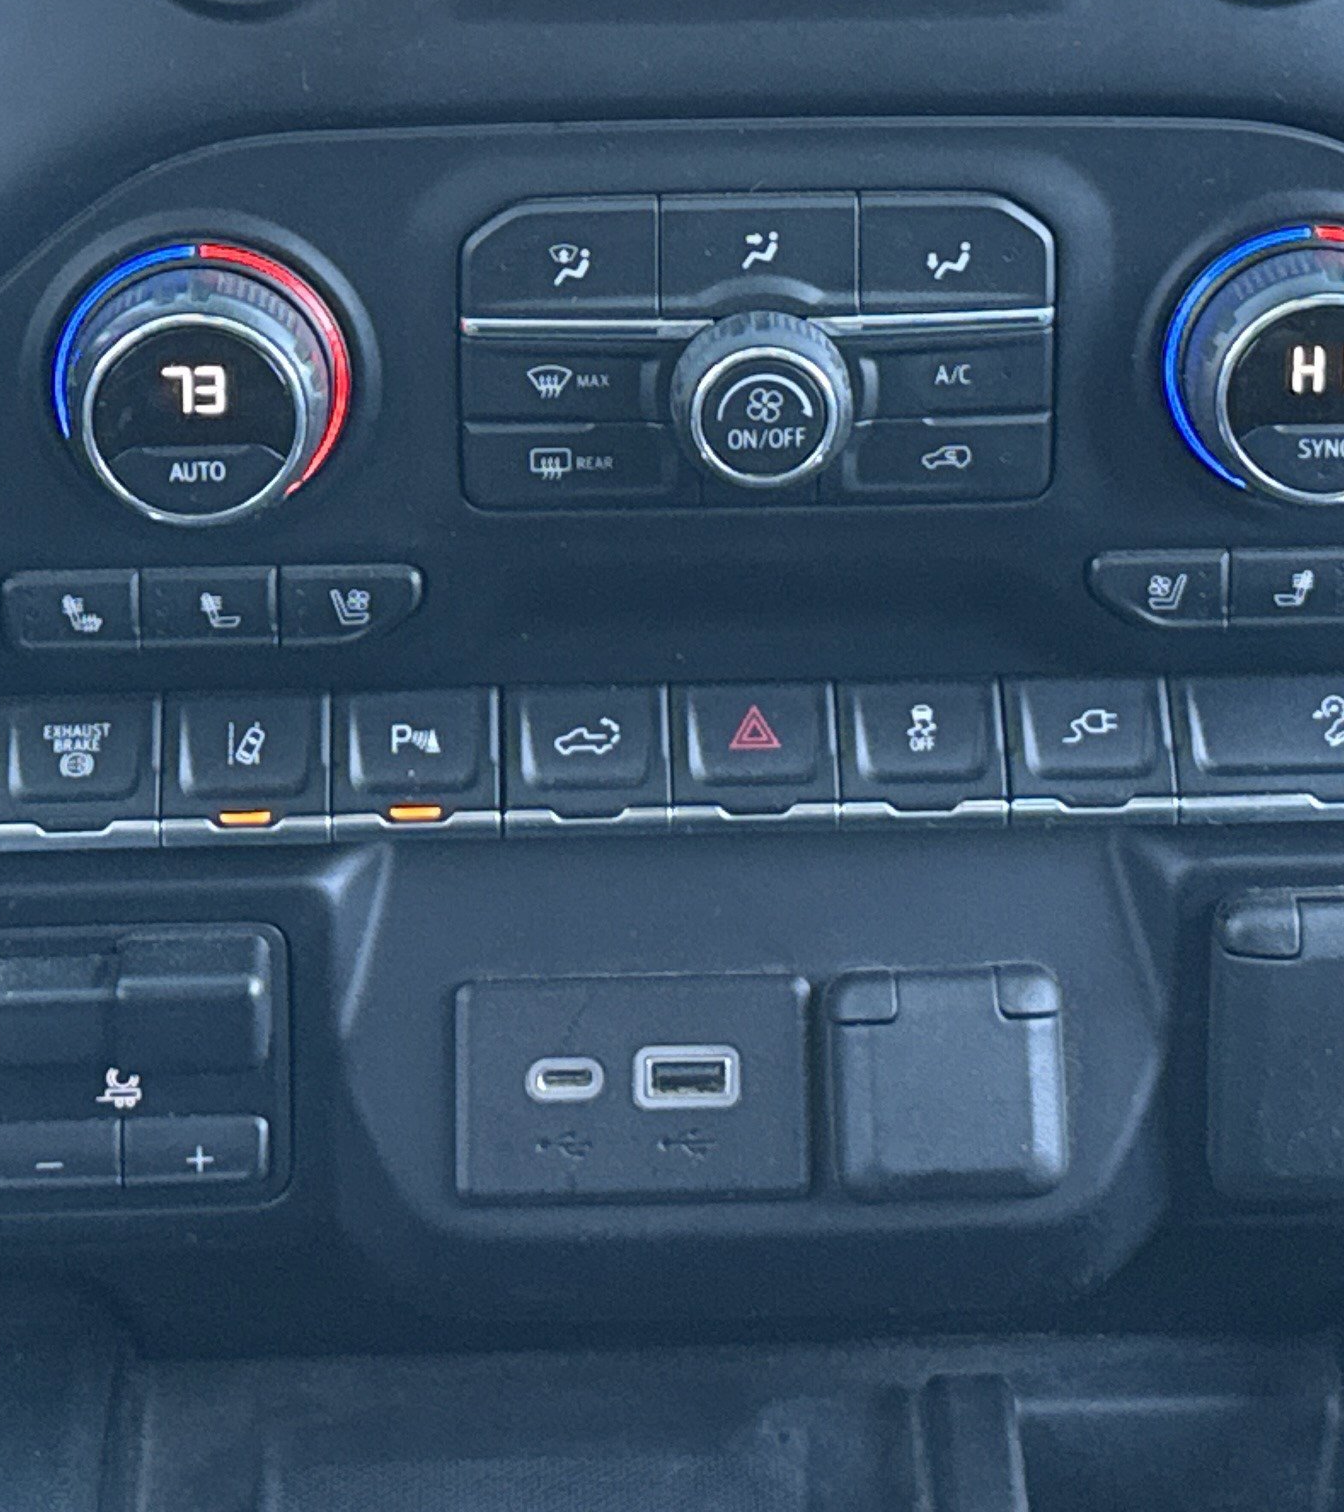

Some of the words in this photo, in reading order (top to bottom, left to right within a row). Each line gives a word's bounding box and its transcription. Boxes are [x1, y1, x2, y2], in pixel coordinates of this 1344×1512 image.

[576, 374, 610, 388] MAX
[935, 364, 971, 386] A/C
[162, 366, 227, 413] 73
[728, 427, 806, 450] ON/OFF
[576, 456, 613, 470] REAR
[169, 462, 226, 482] AUTO
[43, 723, 111, 740] EXHAUST
[54, 738, 100, 753] BRAKE
[910, 736, 936, 752] OFF
